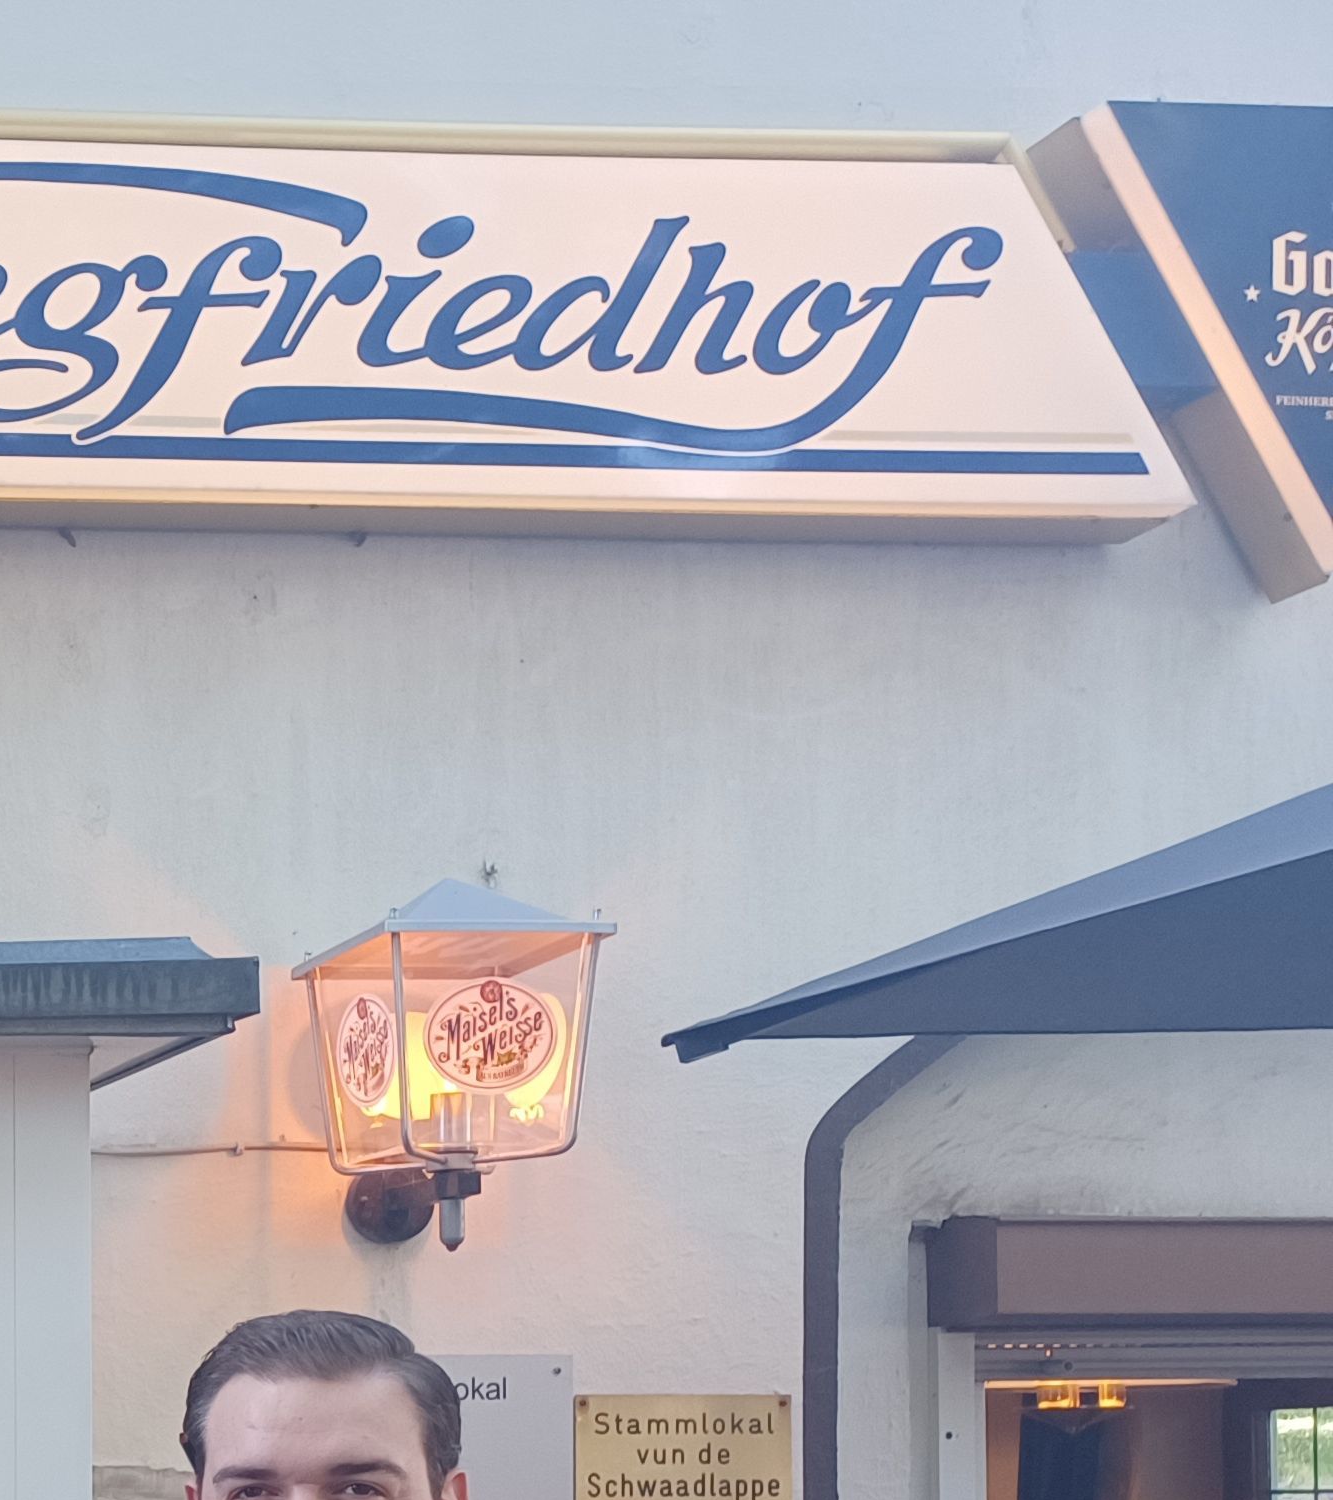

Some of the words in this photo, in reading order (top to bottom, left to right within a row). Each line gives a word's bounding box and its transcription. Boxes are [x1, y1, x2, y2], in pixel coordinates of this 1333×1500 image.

[473, 1011, 545, 1065] Weisse
[454, 1376, 506, 1401] okal
[594, 1412, 774, 1435] Stammlokal
[637, 1448, 684, 1464] vun
[699, 1442, 730, 1465] de
